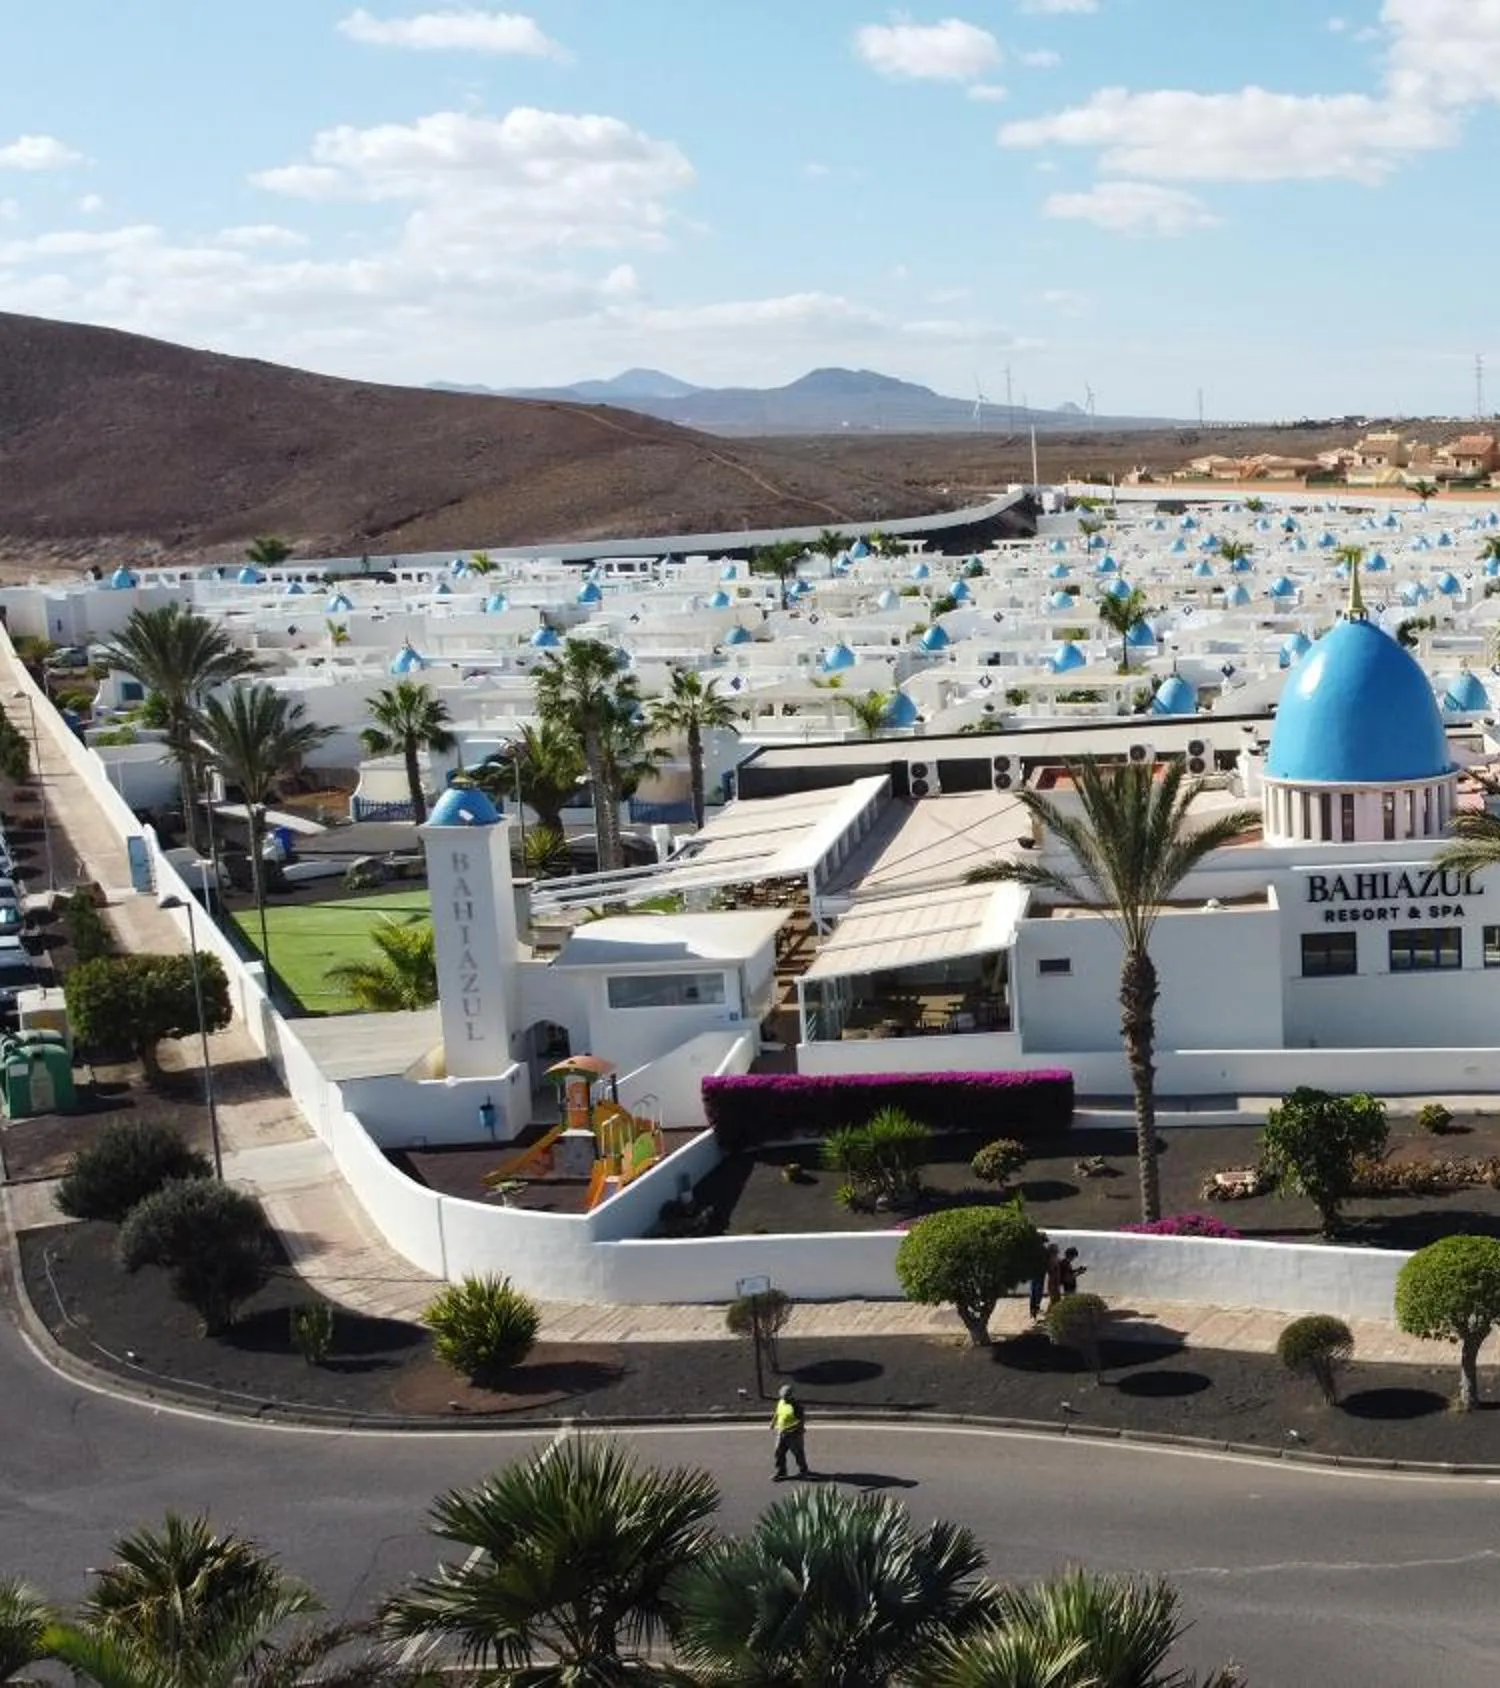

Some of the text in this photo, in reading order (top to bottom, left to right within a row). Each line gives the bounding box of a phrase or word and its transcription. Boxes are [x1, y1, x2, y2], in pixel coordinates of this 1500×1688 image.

[1305, 870, 1485, 903] BAHIAZUL
[1324, 904, 1465, 923] RESORT & SPA
[451, 851, 485, 1042] BAHIAZUL
